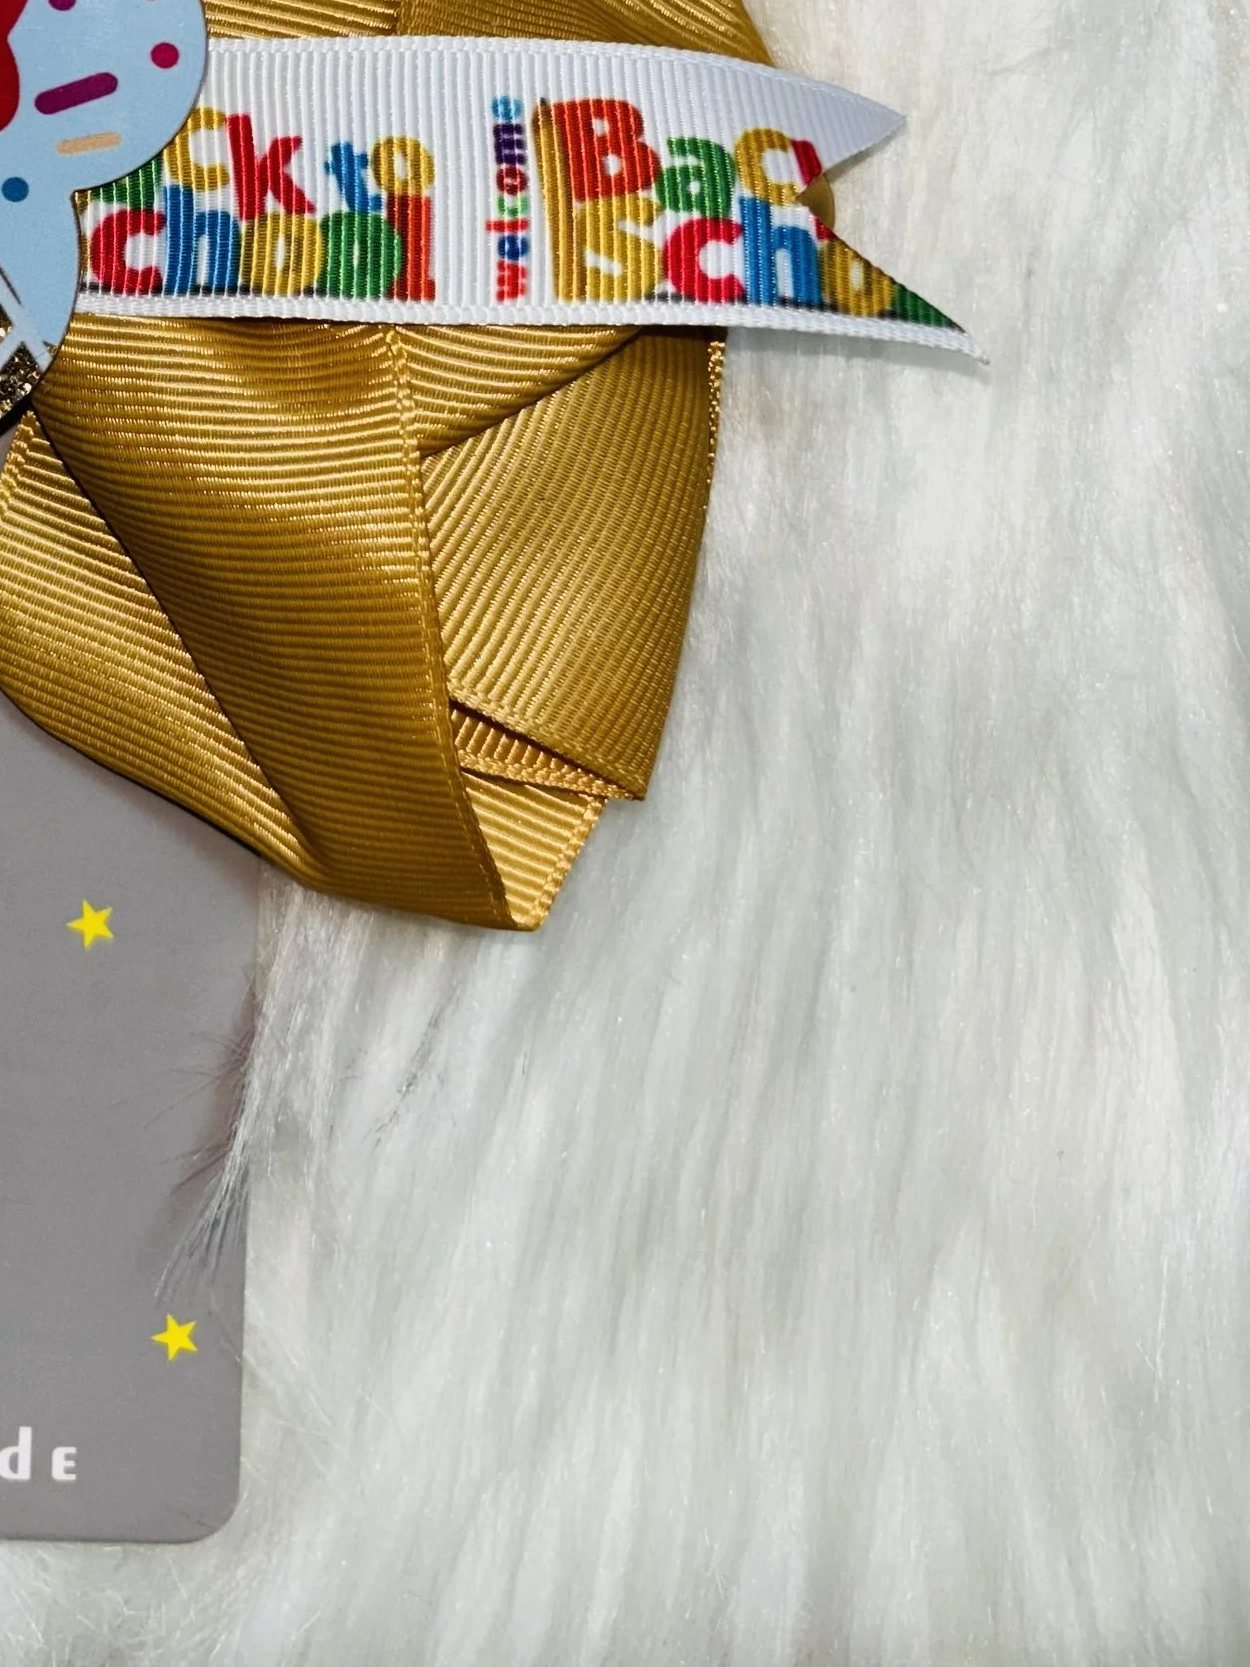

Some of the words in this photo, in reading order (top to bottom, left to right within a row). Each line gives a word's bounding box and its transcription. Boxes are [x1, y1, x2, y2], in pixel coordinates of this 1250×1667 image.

[323, 136, 436, 212] to
[552, 97, 824, 208] Bac
[74, 183, 437, 302] chool
